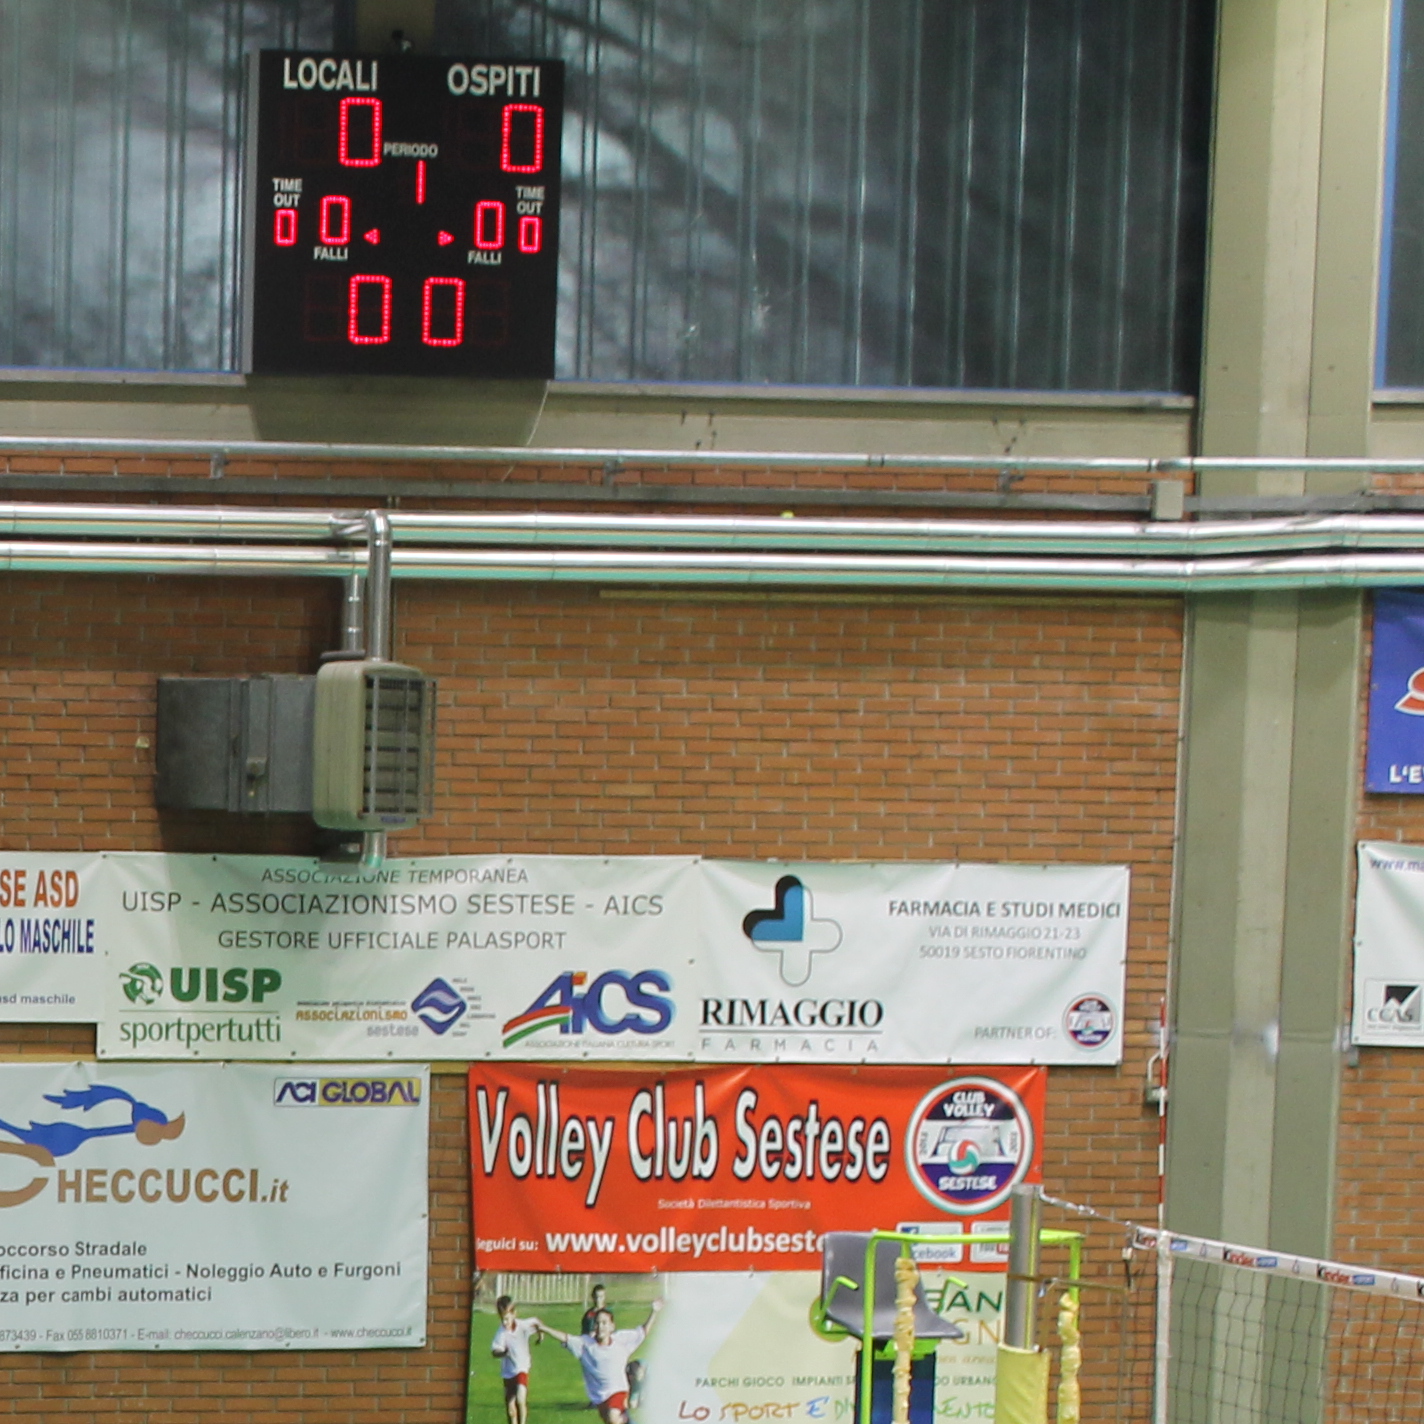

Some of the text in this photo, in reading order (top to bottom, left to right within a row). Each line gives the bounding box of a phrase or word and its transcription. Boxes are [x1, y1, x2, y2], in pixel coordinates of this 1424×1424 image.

[283, 57, 378, 91] LOCALI
[447, 63, 541, 97] OSPITI
[339, 96, 383, 167] 0
[500, 103, 545, 173] 0
[383, 142, 439, 158] PERIODO
[272, 178, 302, 192] TIME
[515, 186, 545, 199] TIME
[273, 193, 300, 208] OUT
[517, 201, 543, 215] OUT
[274, 208, 298, 246] 0
[320, 195, 350, 245] 0
[474, 201, 505, 250] 0
[518, 216, 542, 254] 0
[313, 246, 348, 261] FALLI
[468, 251, 501, 265] FALLI
[348, 274, 392, 345] 0
[422, 276, 466, 347] 0
[408, 868, 529, 885] TEMPORANEA
[33, 869, 80, 909] ASD
[122, 891, 664, 916] UISP ASSOCIAZIONISMO SESTESE AICS
[889, 900, 1121, 919] FARMACIA E STUDI MEDICI
[19, 918, 95, 954] MASCHILE
[218, 930, 568, 950] GESTORE UFFICIALE PALASPORT
[928, 925, 1081, 941] VIA RIMAGGIO 21-23
[919, 945, 1087, 961] 50019 SESTO FIORENTINO
[169, 967, 283, 1003] UISP
[20, 992, 76, 1005] maschile
[702, 999, 884, 1028] RIMAGGIO
[119, 1015, 282, 1049] sportpertutti
[974, 1026, 1032, 1040] PARTNER
[276, 1080, 422, 1104] ACI GLOBAL
[952, 1091, 986, 1103] CLUB
[943, 1103, 995, 1118] VOLLEY
[476, 1081, 892, 1208] Volley Club Sestese
[938, 1176, 998, 1191] SESTESE
[75, 1240, 147, 1257] Stradale
[519, 1240, 539, 1251] su:
[71, 1261, 401, 1282] Pneumatici Noleggio Auto Furgoni
[25, 1290, 55, 1306] per
[61, 1287, 112, 1303] cambi
[118, 1286, 212, 1303] automatici
[45, 1330, 65, 1342] Fax
[695, 1377, 739, 1388] PARCHI
[743, 1376, 785, 1387] GIOCO
[792, 1375, 843, 1387] IMPIANTI
[718, 1401, 801, 1422] SPORT
